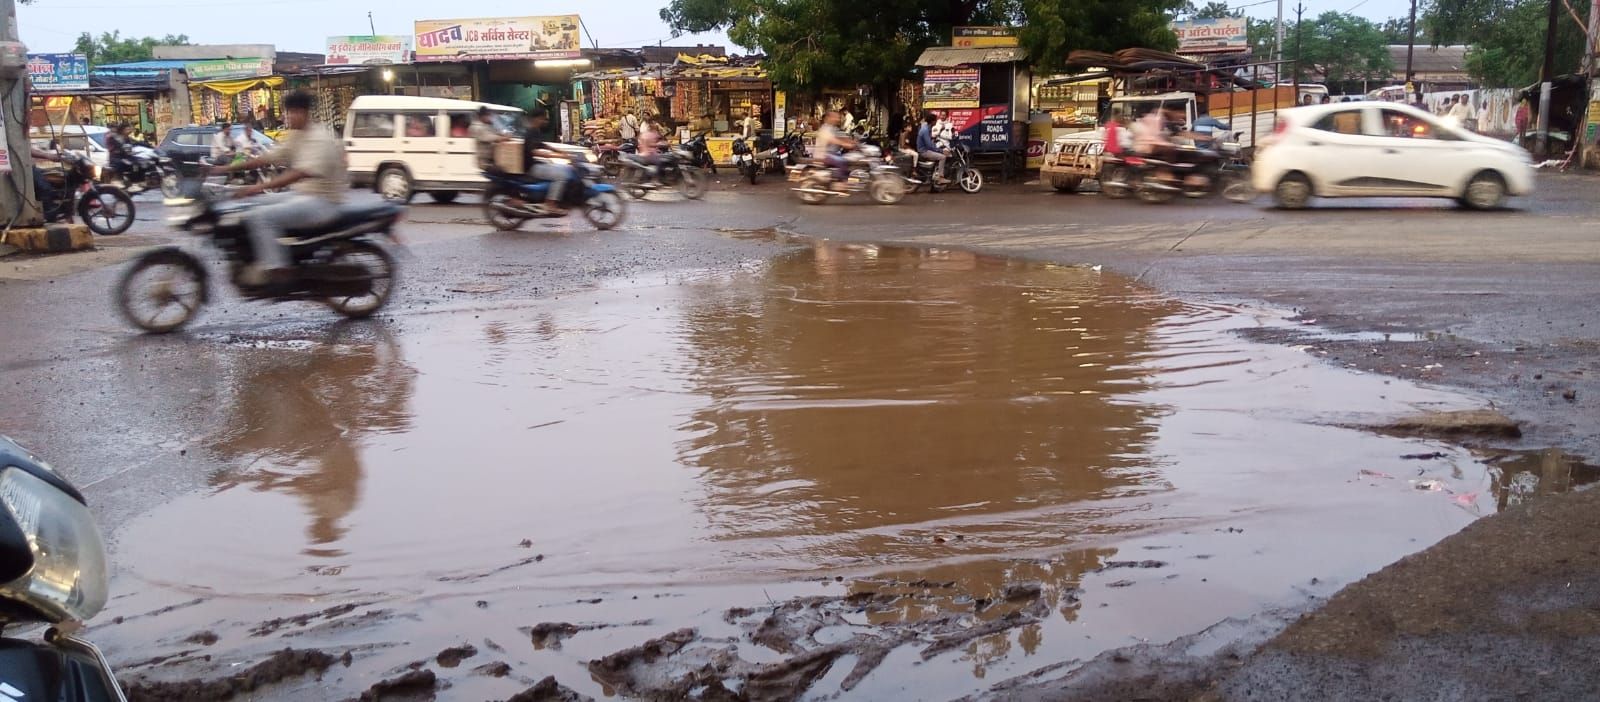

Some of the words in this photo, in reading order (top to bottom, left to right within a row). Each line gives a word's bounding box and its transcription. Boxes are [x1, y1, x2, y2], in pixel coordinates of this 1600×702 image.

[417, 25, 463, 48] यादव
[465, 29, 479, 42] JCB
[481, 28, 505, 42] सर्विस
[507, 27, 530, 40] सेन्टर
